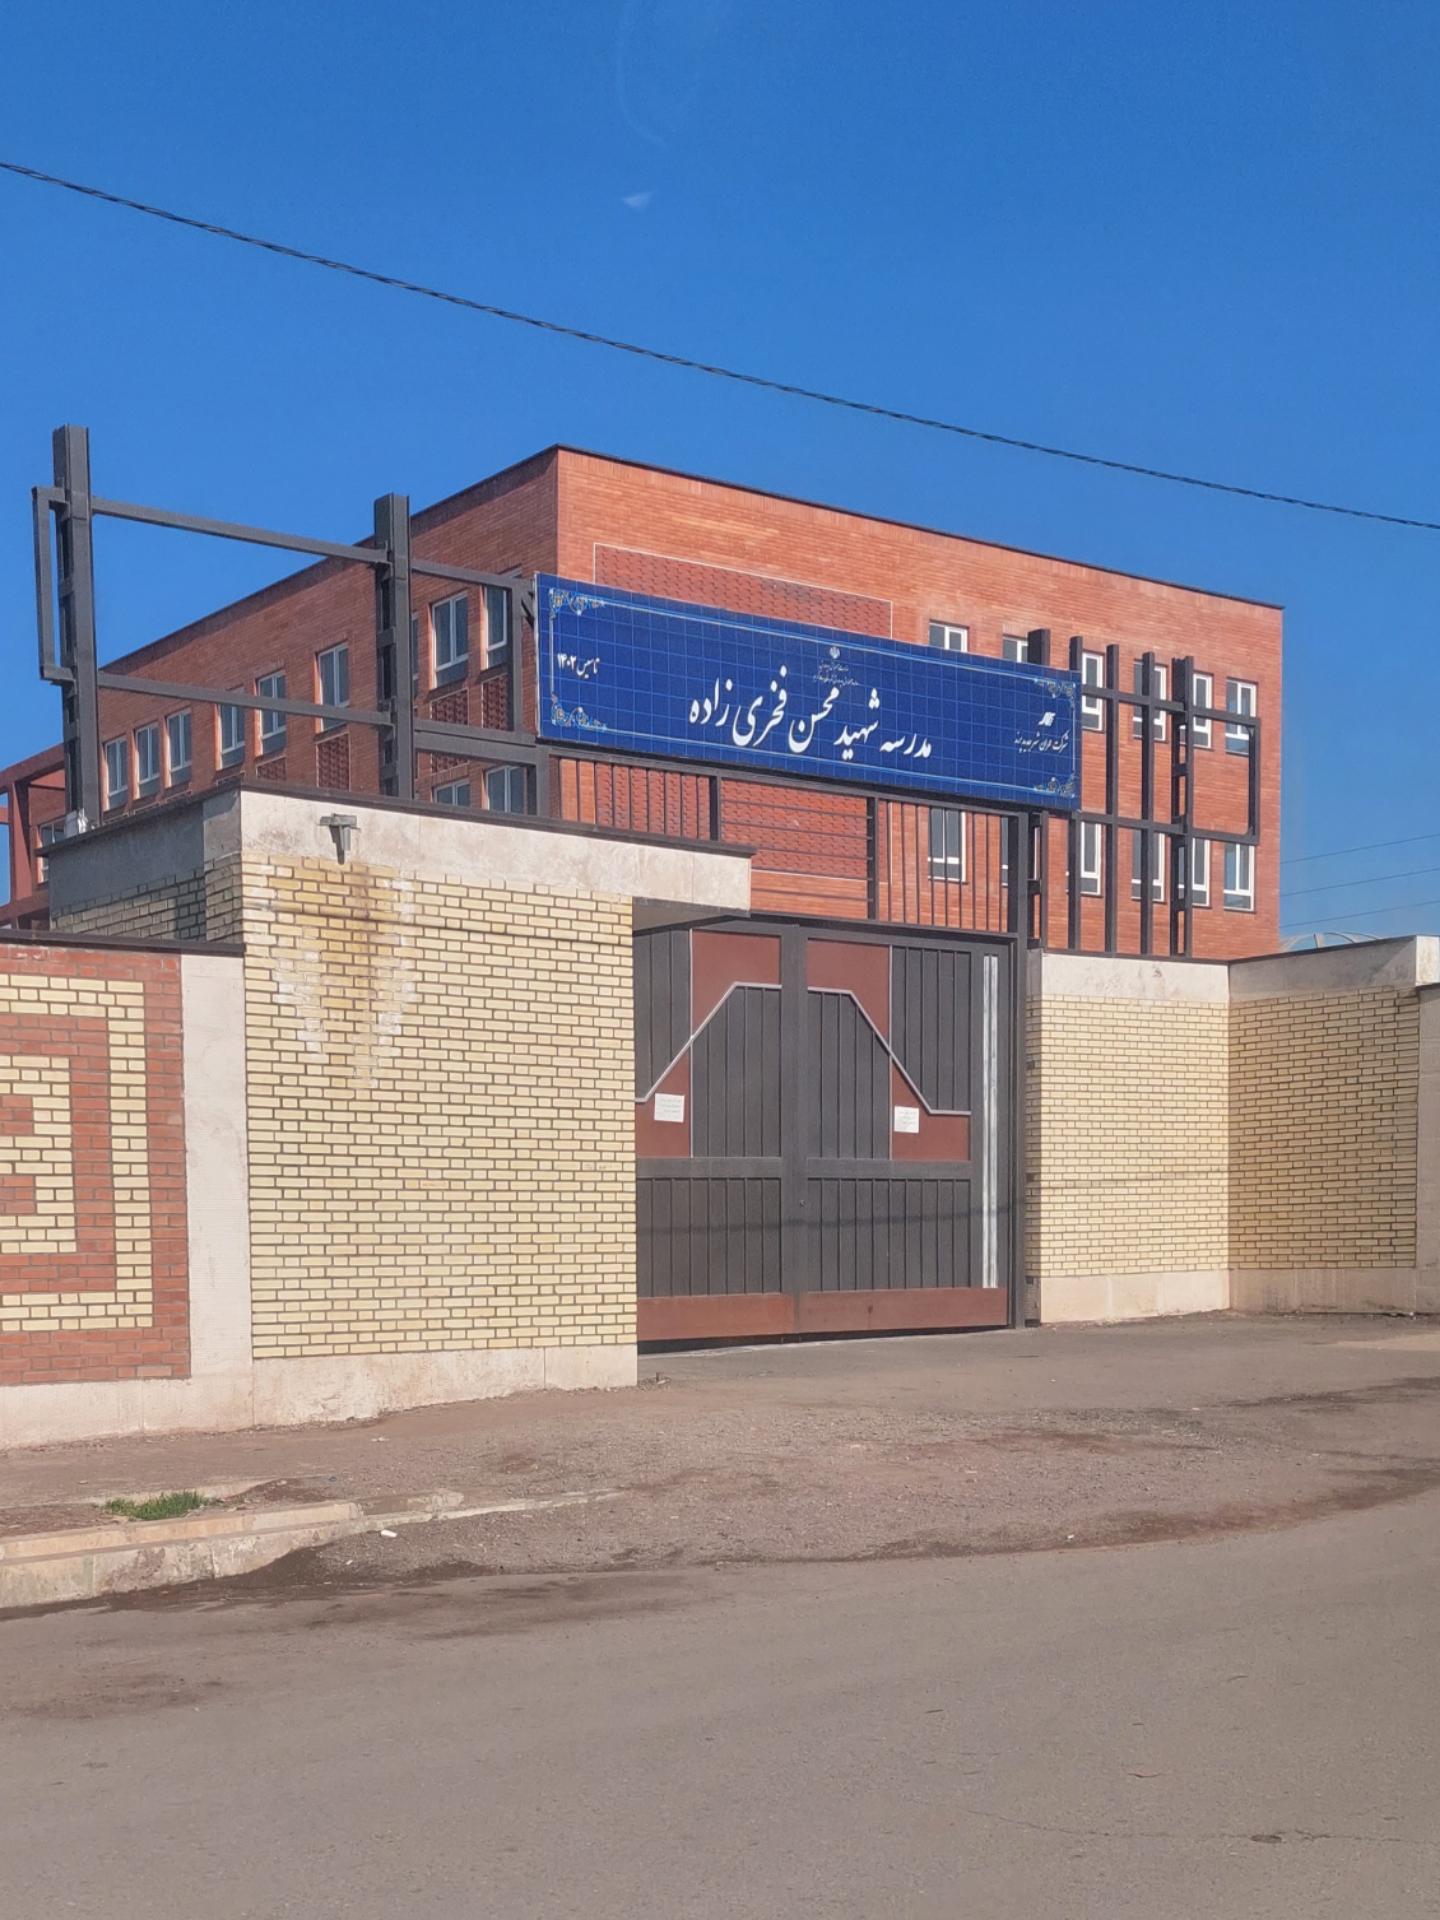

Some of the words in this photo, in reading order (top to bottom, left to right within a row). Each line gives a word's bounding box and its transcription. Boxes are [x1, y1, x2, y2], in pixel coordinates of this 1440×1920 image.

[689, 677, 734, 727] زاده
[732, 665, 788, 747] فخری
[788, 686, 840, 753] محسن
[834, 687, 880, 760] شهید
[880, 733, 932, 758] مدرسه
